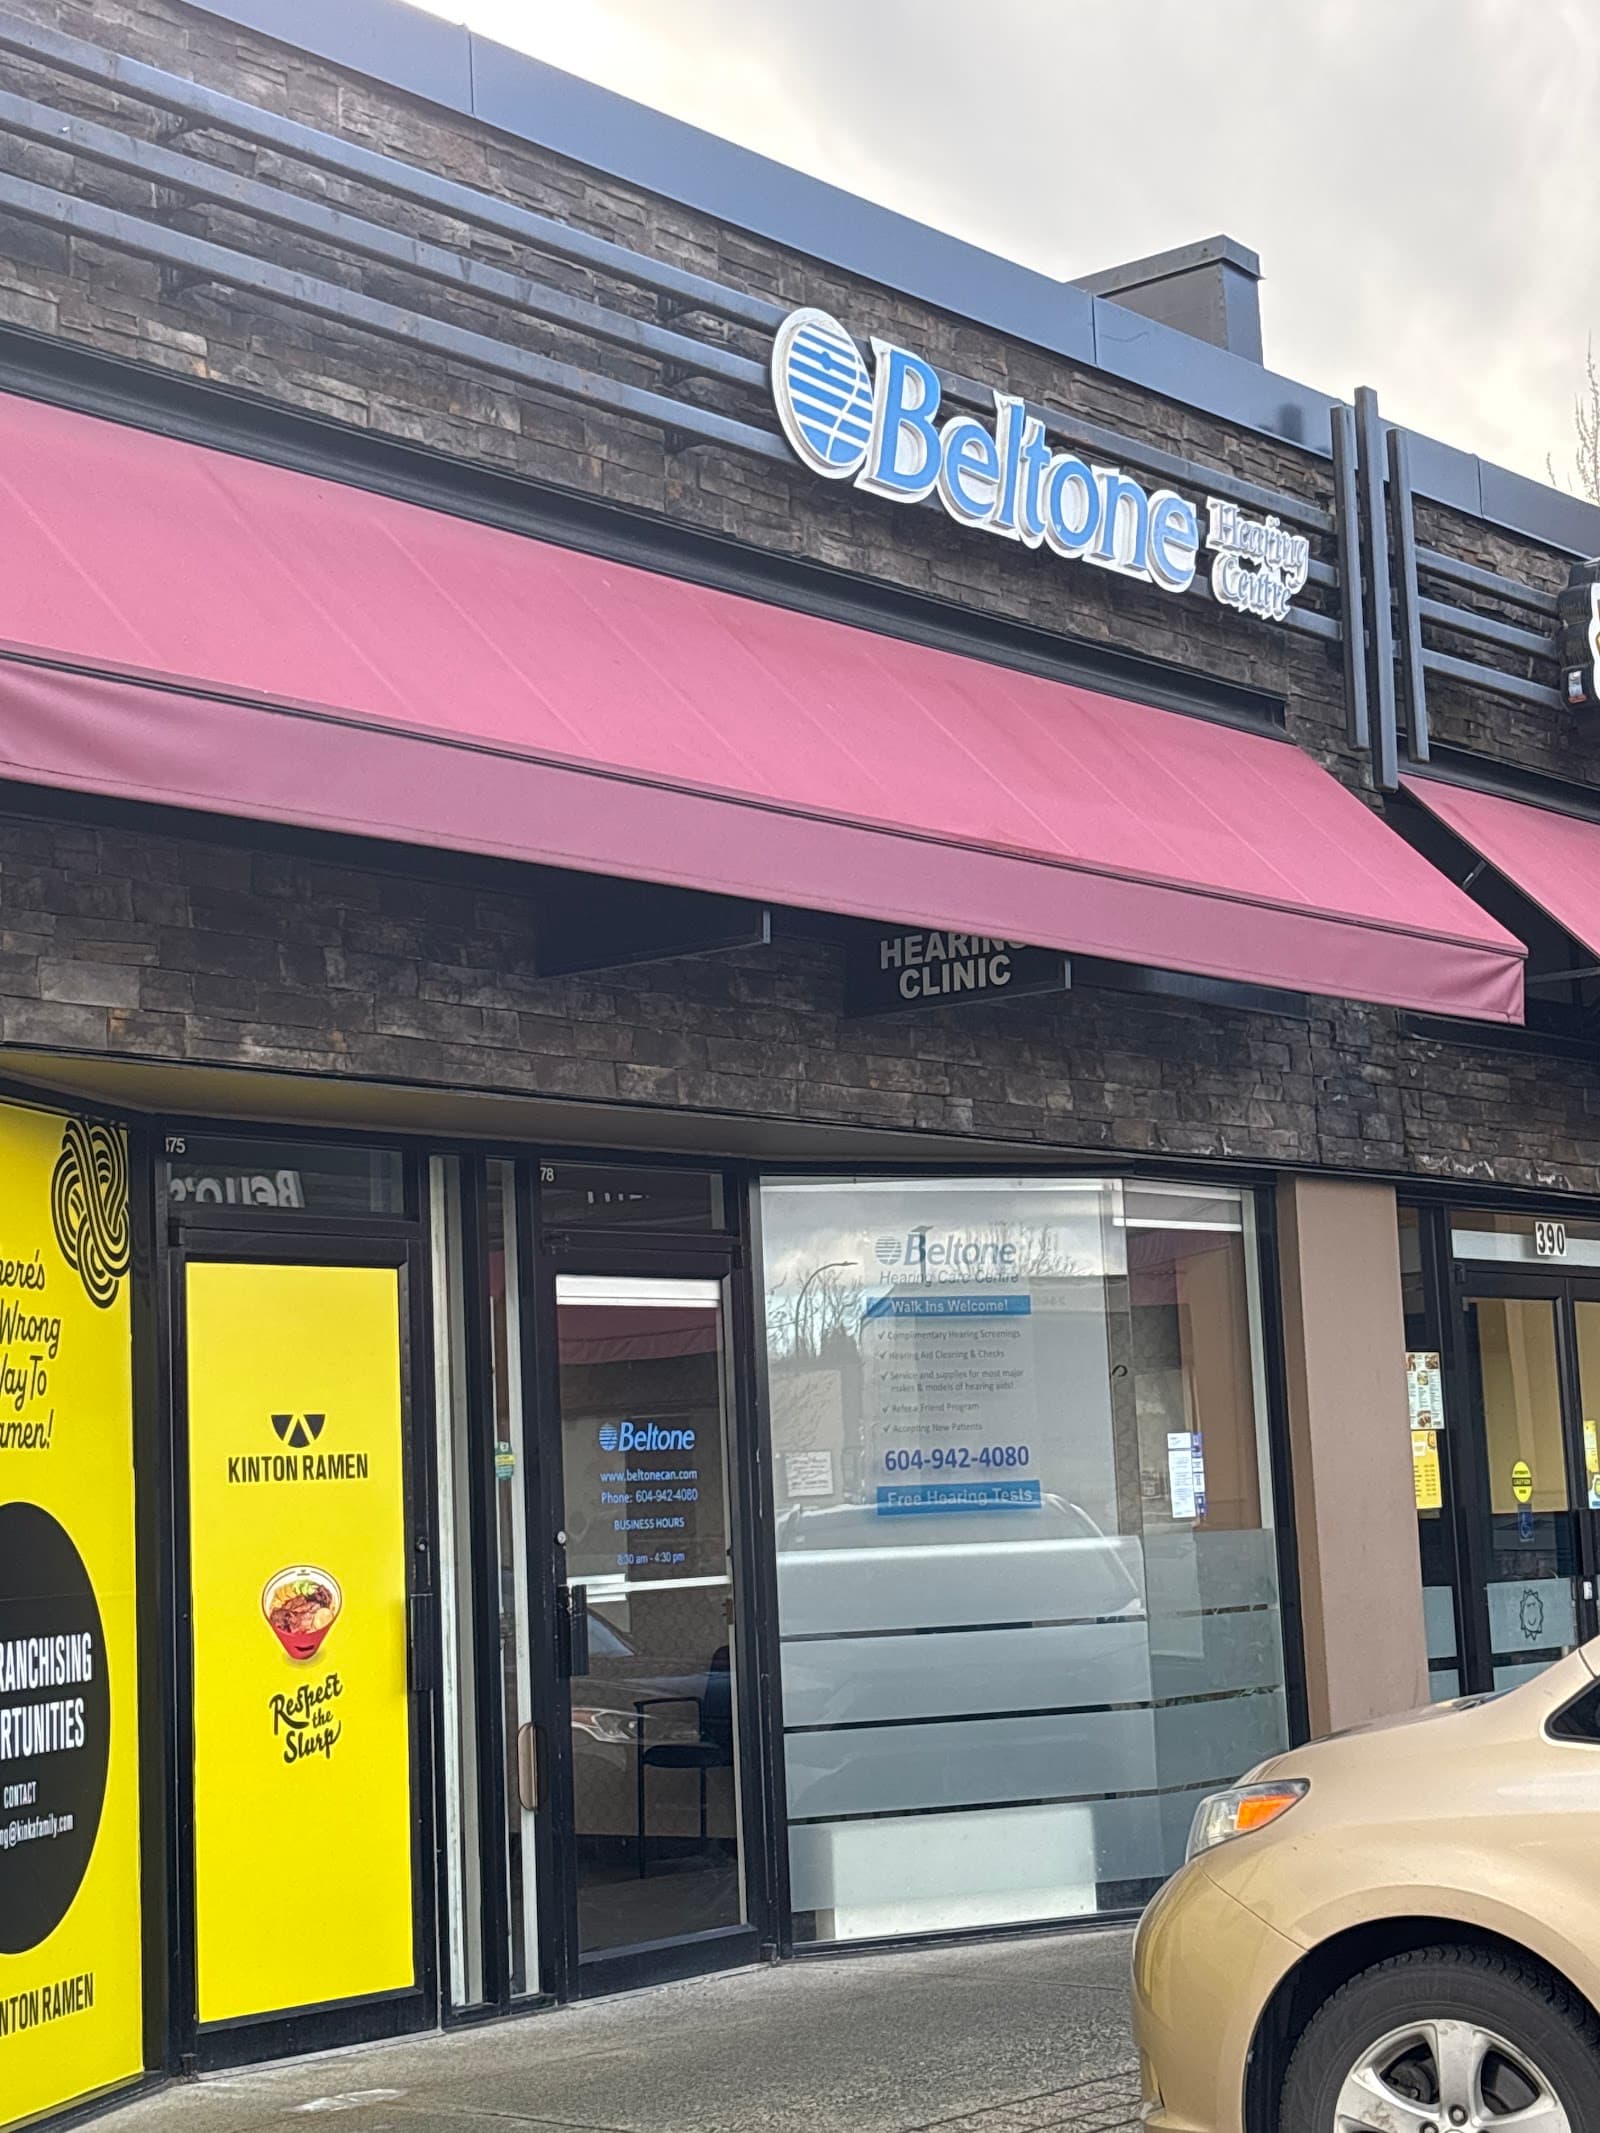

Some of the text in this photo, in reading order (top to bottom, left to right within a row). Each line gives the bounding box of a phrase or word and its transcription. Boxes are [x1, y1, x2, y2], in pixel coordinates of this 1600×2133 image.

[862, 340, 1197, 590] Beltone
[1206, 497, 1308, 594] Hearing
[1213, 552, 1291, 620] Centre
[899, 955, 1011, 1000] CLINIC
[165, 1136, 186, 1154] 75
[903, 1232, 1017, 1266] Beltone
[1537, 1223, 1565, 1255] 390
[891, 1298, 1009, 1313] Walk Ins Welcome!
[935, 1350, 968, 1361] Cleaning
[970, 1350, 976, 1358] &
[978, 1349, 1005, 1358] Checks
[30, 1356, 47, 1401] To
[917, 1383, 924, 1392] &
[955, 1382, 963, 1391] of
[965, 1382, 994, 1392] hearing
[919, 1370, 934, 1379] and
[968, 1369, 979, 1378] for
[617, 1421, 696, 1452] Beltone
[227, 1453, 368, 1483] KINTON RAMEN
[885, 1446, 1029, 1471] 604-942-4080
[600, 1469, 698, 1482] www.beltonecan.com
[601, 1487, 699, 1504] Phone: 604-942-4080
[887, 1486, 1033, 1507] Free Hearing Tests
[614, 1516, 685, 1531] BUSINESS HOURS
[268, 1672, 343, 1736] Respect
[312, 1708, 334, 1728] the
[283, 1720, 342, 1764] Slurp
[3, 1781, 37, 1809] CONTACT
[42, 1972, 94, 2023] RAMEN
